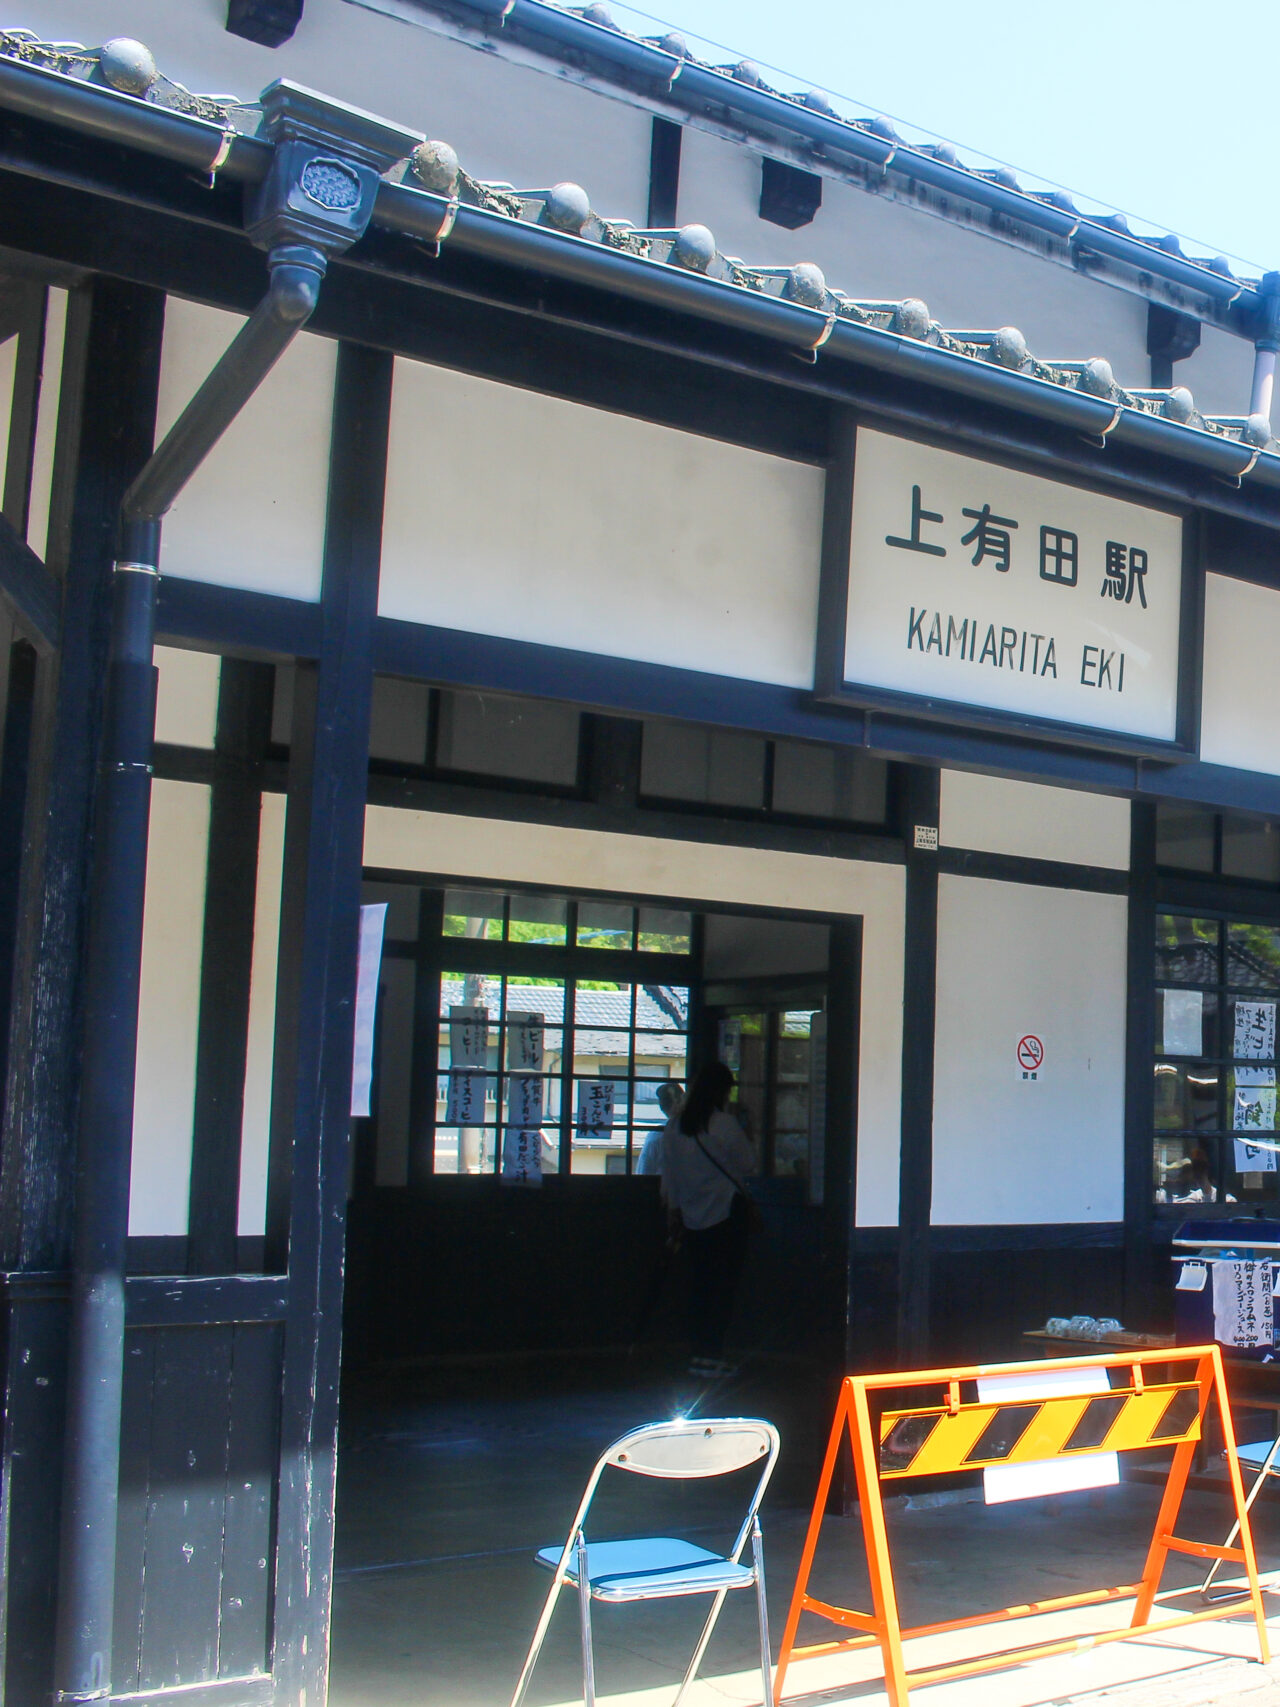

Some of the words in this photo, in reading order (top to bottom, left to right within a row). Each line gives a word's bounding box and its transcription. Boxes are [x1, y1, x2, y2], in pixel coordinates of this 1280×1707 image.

[885, 485, 1149, 610] 上有田駅
[907, 607, 1058, 680] KAMIARITA
[1080, 645, 1126, 693] EKI
